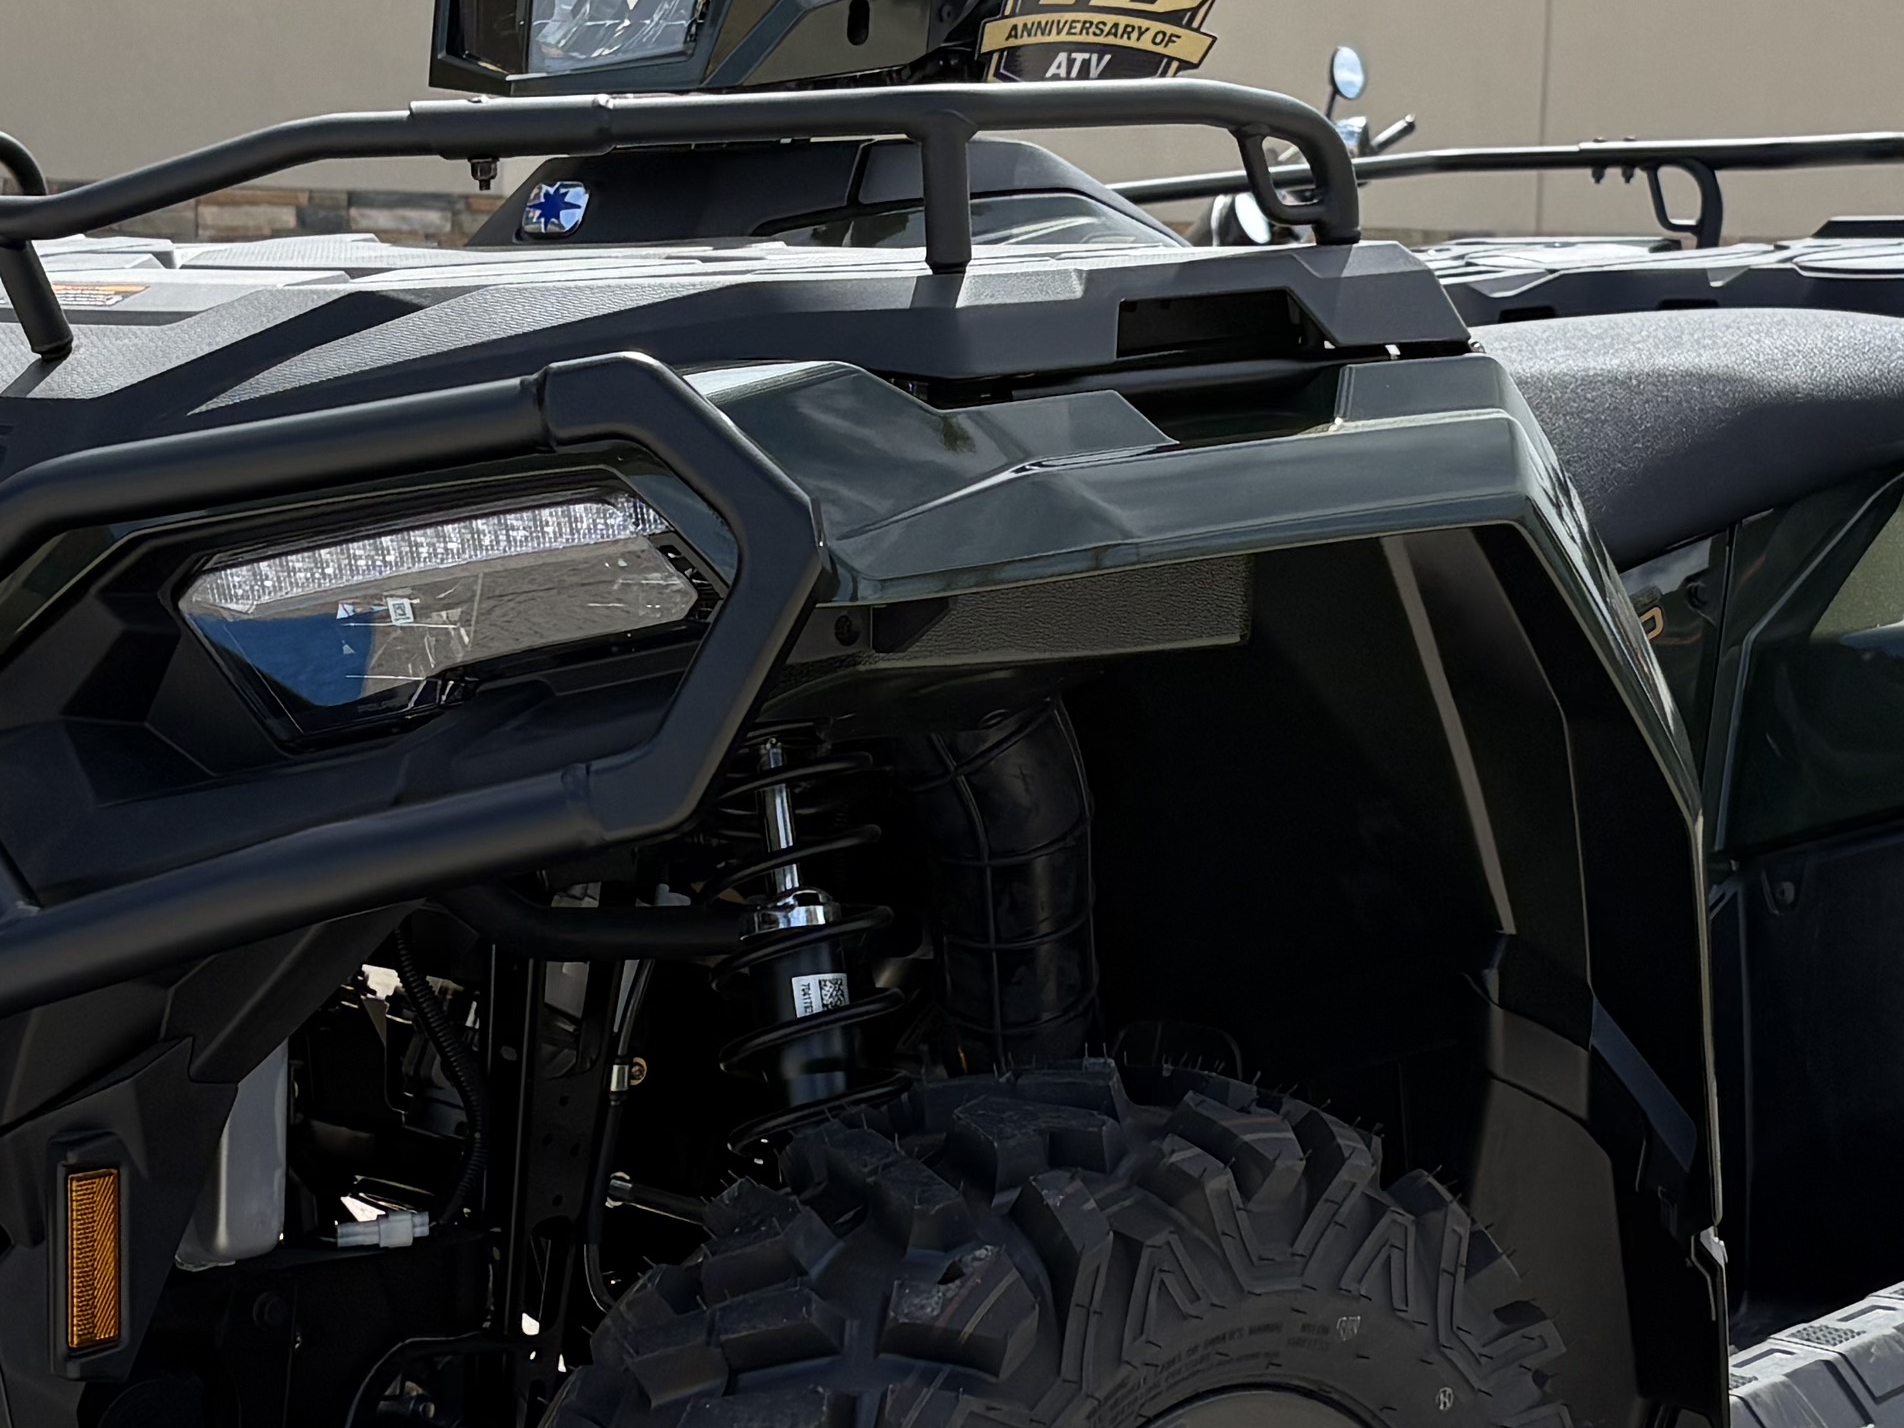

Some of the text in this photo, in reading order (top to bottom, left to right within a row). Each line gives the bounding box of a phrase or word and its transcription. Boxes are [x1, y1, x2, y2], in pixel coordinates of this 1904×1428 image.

[1005, 19, 1182, 49] ANNIVERSARY OF
[1045, 51, 1112, 79] ATV
